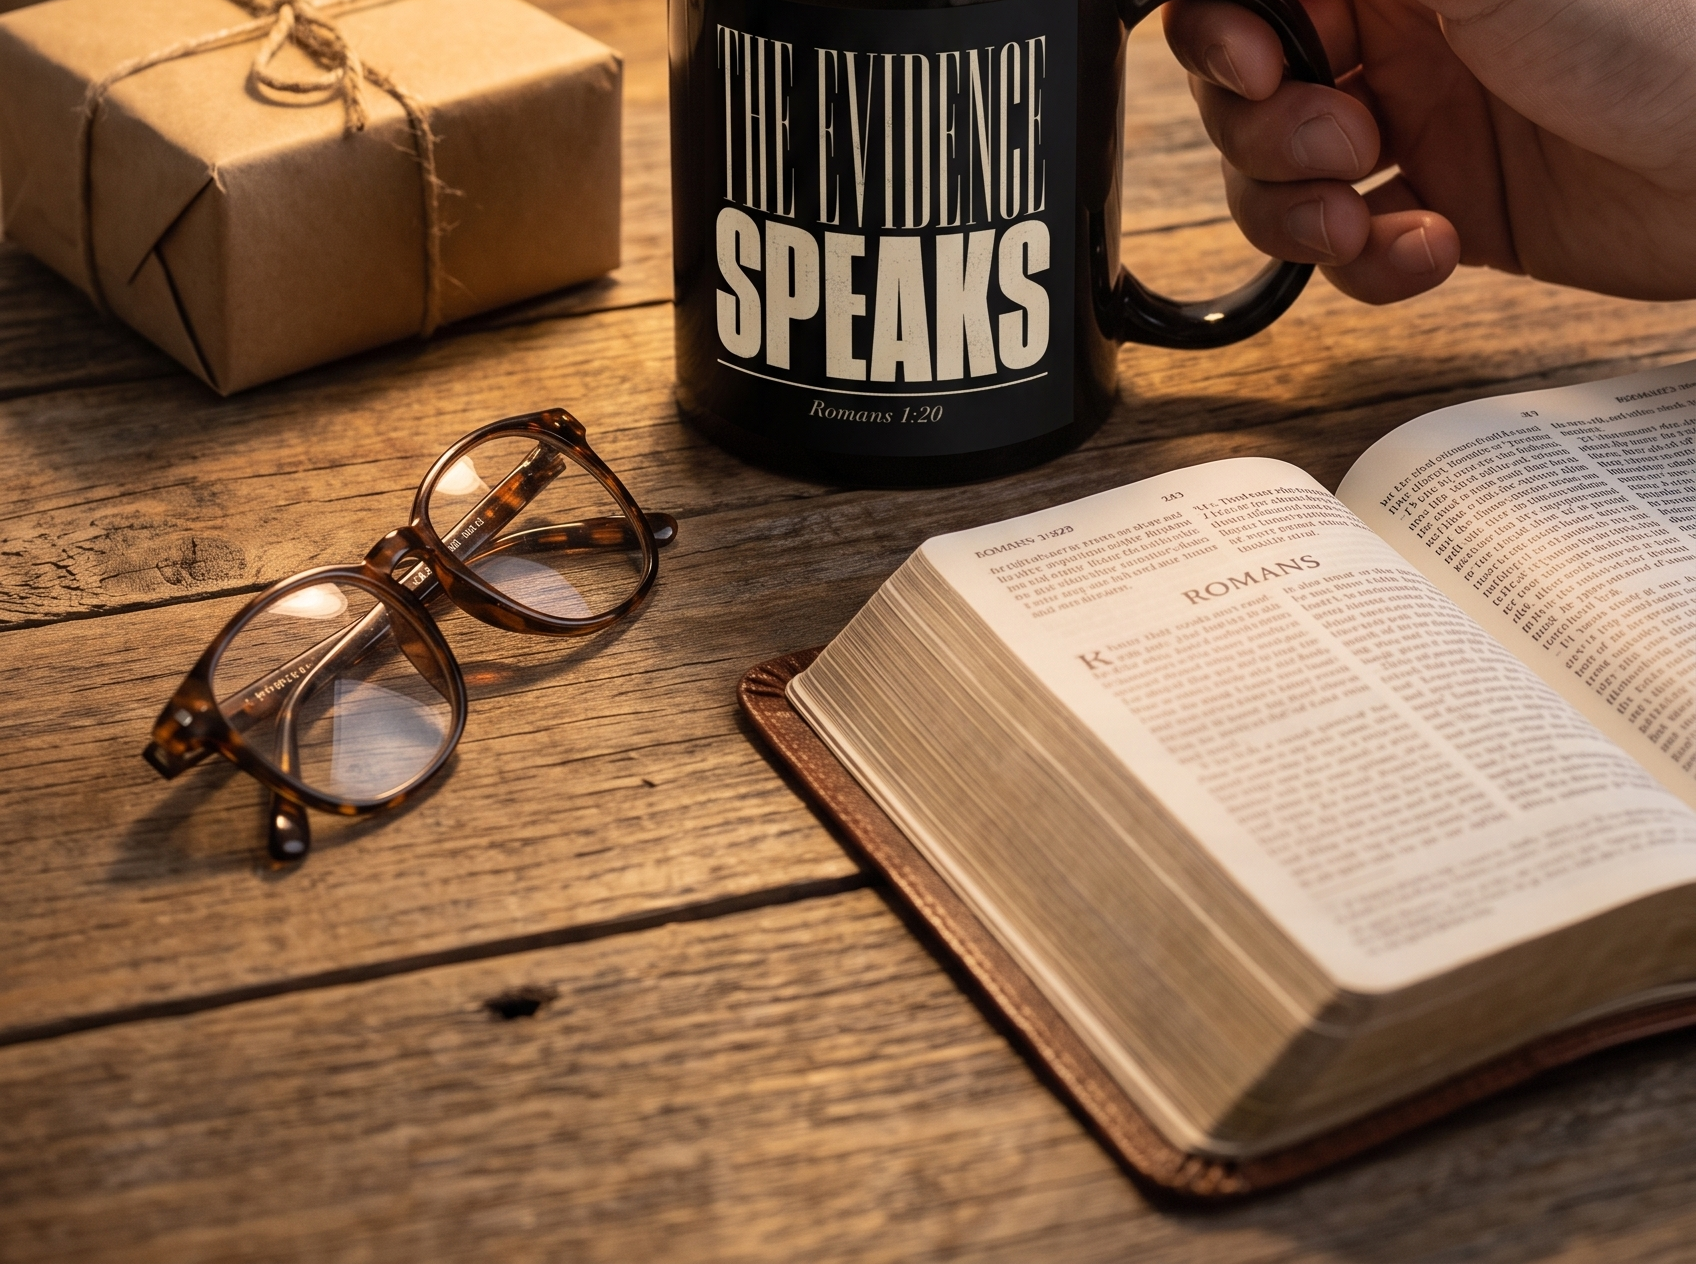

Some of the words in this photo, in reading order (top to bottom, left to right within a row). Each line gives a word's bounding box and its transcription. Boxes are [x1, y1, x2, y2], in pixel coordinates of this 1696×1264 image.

[716, 24, 796, 219] THE
[813, 35, 1048, 230] EVIDENCE
[716, 206, 1050, 382] SPEAKS
[808, 398, 894, 424] Romans
[900, 404, 944, 424] 1:20
[1181, 554, 1321, 605] ROMANS
